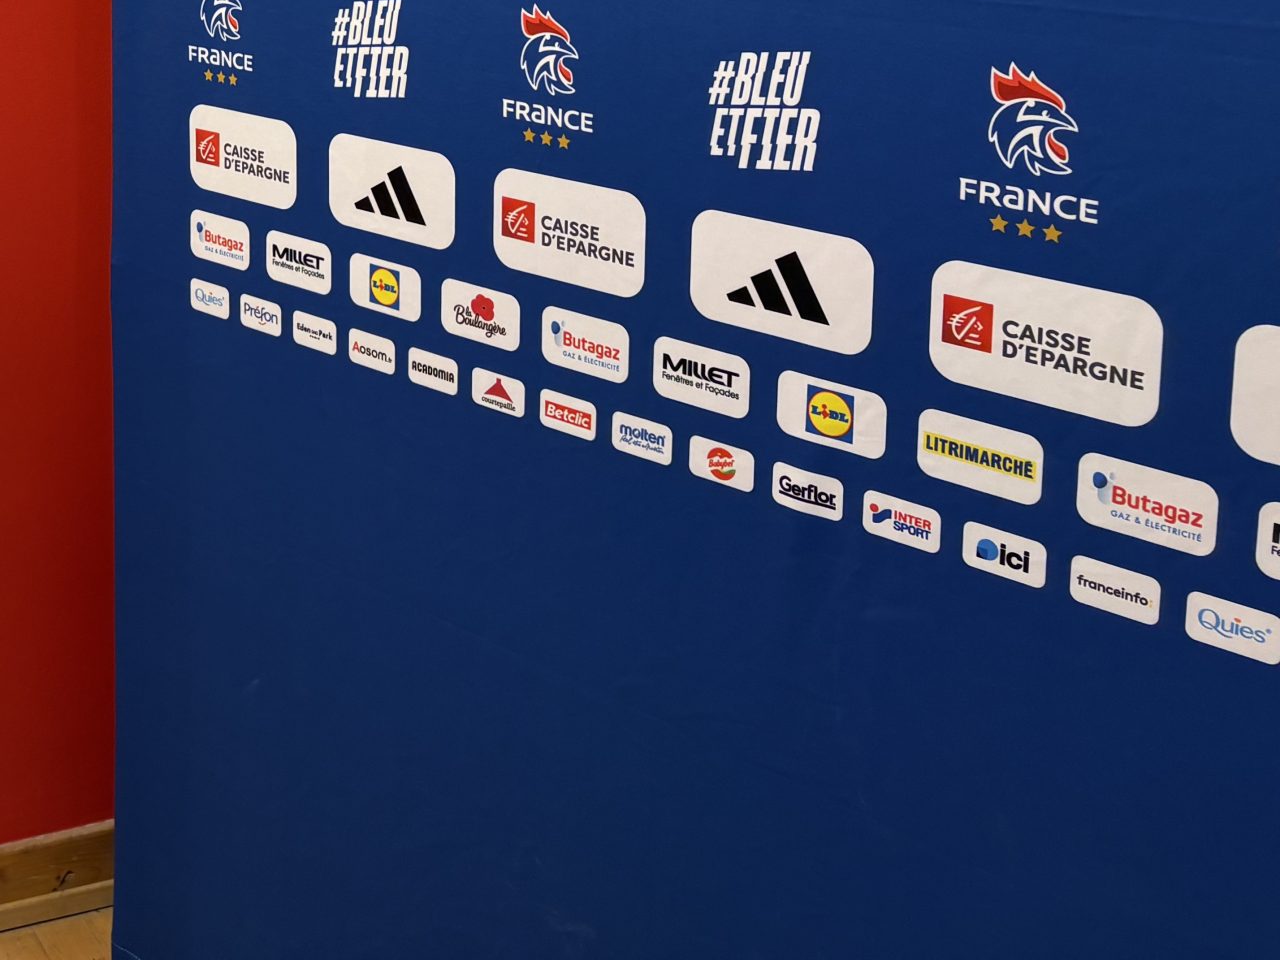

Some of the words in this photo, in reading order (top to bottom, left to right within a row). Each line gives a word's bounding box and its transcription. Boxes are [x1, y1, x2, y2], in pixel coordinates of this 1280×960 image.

[331, 0, 402, 46] #BLEU
[708, 51, 811, 106] #BLEU
[224, 143, 265, 164] CAISSE
[224, 156, 290, 184] D'EPARGNE
[204, 229, 244, 252] Butagaz
[541, 215, 600, 241] CAISSE
[272, 244, 325, 270] MILLET
[541, 233, 635, 267] D'EPARGNE
[244, 302, 278, 325] Préfon
[454, 304, 506, 338] Boulangère
[297, 323, 310, 333] Eden
[319, 330, 333, 341] Park
[563, 331, 620, 360] Butagaz
[1002, 320, 1091, 356] CAISSE
[411, 360, 455, 384] ACADOMIA
[562, 350, 575, 360] GAZ
[584, 356, 620, 372] ÉLECTRICITÉ
[662, 353, 740, 388] MILLET
[1002, 340, 1145, 391] D'EPARGNE
[662, 370, 694, 387] Fenêtres
[695, 380, 704, 389] et
[705, 384, 739, 400] Façades
[481, 396, 516, 411] courtepaille
[546, 403, 590, 428] Betclic
[620, 423, 666, 447] molten
[708, 459, 735, 470] Babybel
[926, 434, 1033, 479] LITRIMARCHÉ
[894, 510, 932, 530] INTER
[1111, 485, 1203, 528] Butagaz
[893, 521, 931, 540] SPORT
[1110, 510, 1130, 521] GAZ
[1144, 518, 1202, 542] ÉLECTRICITÉ
[999, 543, 1030, 574] ici
